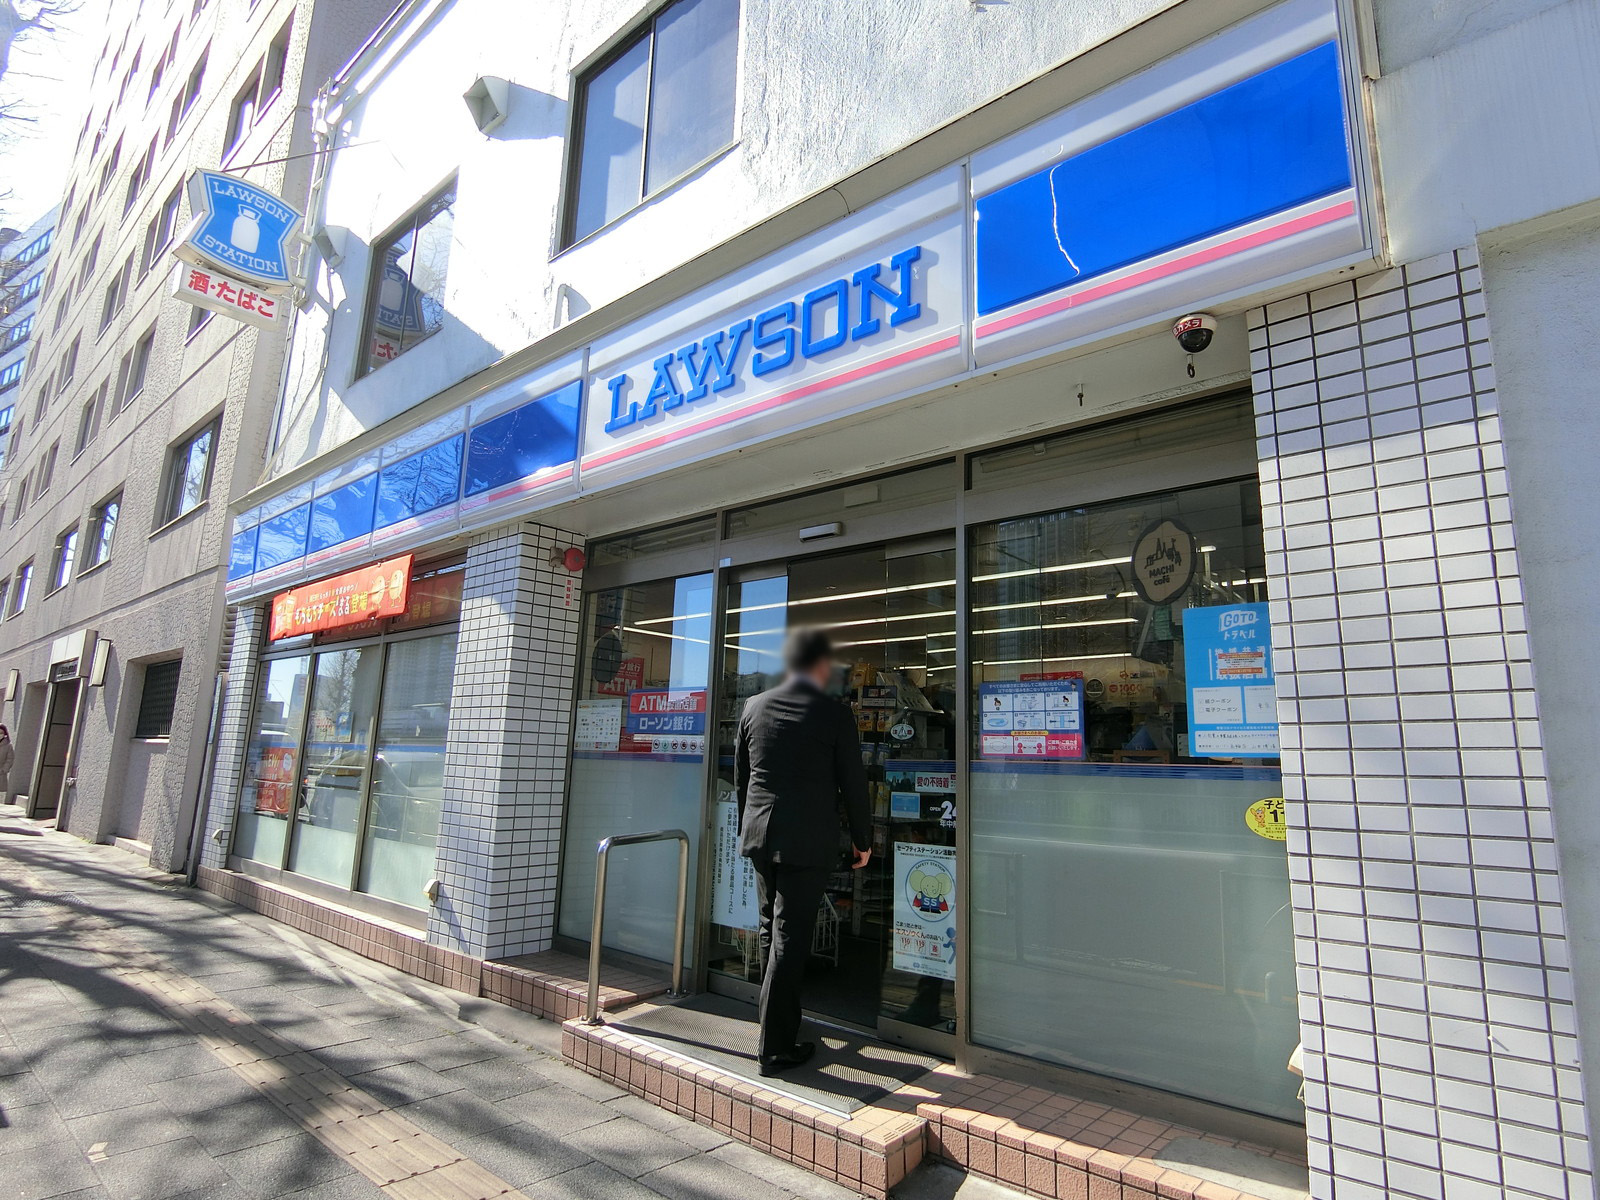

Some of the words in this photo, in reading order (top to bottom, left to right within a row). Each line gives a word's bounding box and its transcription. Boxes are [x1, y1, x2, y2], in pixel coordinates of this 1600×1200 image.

[212, 181, 290, 223] LAWSON
[202, 234, 279, 273] STATION
[188, 269, 275, 318] 酒・たばこ
[604, 245, 921, 434] LAWSON
[1149, 564, 1175, 579] MACHI
[1153, 574, 1171, 586] café
[1223, 629, 1256, 640] トラベル
[603, 677, 637, 692] ATM
[639, 716, 694, 731] ローソン銀行
[917, 776, 949, 789] 愛の不時着
[915, 862, 929, 870] SAFETY
[930, 862, 946, 873] STATION
[923, 897, 938, 907] SS
